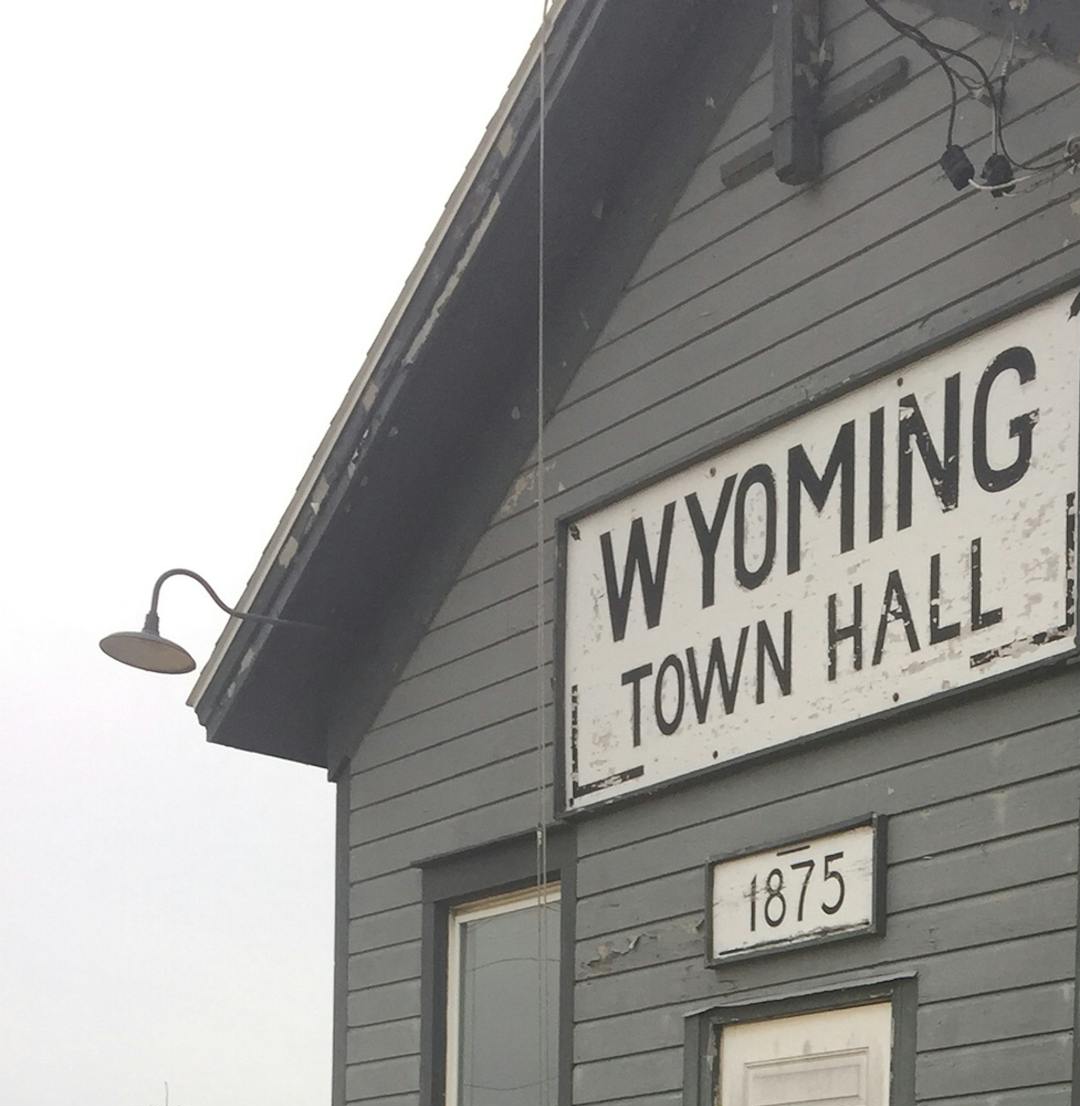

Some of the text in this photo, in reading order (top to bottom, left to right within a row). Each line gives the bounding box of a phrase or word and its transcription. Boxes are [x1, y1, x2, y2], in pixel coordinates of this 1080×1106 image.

[600, 346, 1039, 642] WYOMING
[621, 537, 1003, 747] TOWN HALL
[750, 851, 845, 932] 1875
